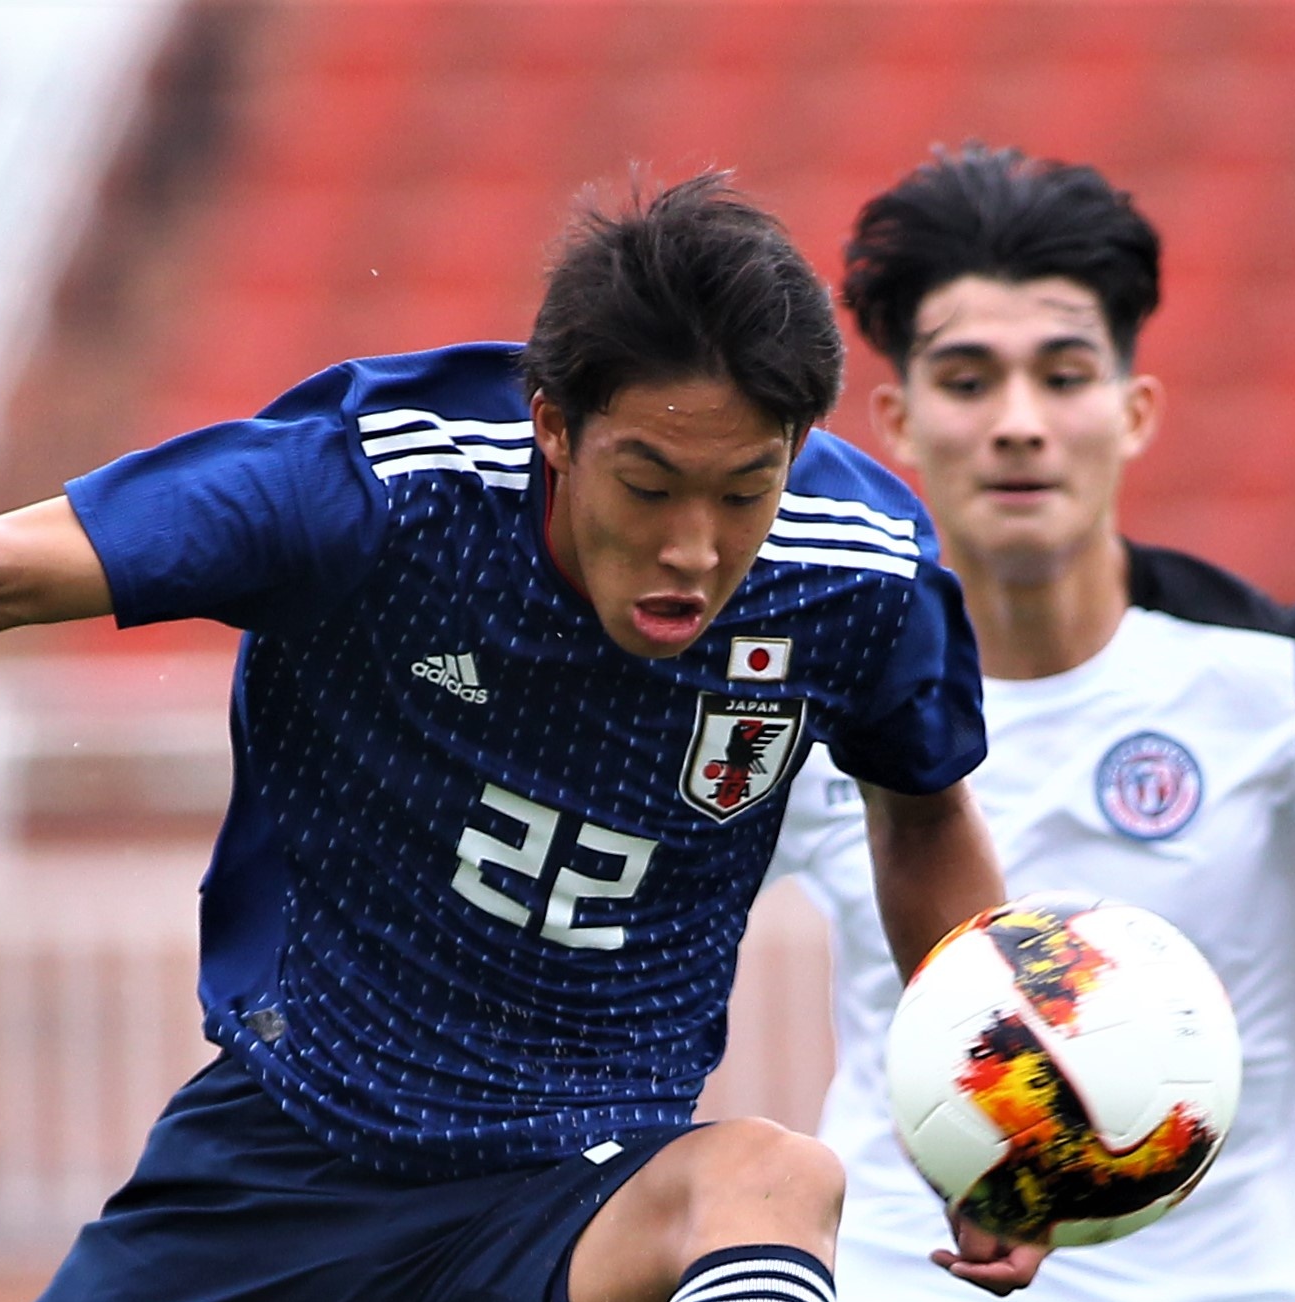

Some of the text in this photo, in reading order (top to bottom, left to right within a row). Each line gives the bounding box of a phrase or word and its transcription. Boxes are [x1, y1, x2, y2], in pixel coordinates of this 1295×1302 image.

[411, 662, 488, 704] adidas
[726, 701, 780, 713] JAPAN
[451, 783, 659, 950] 22
